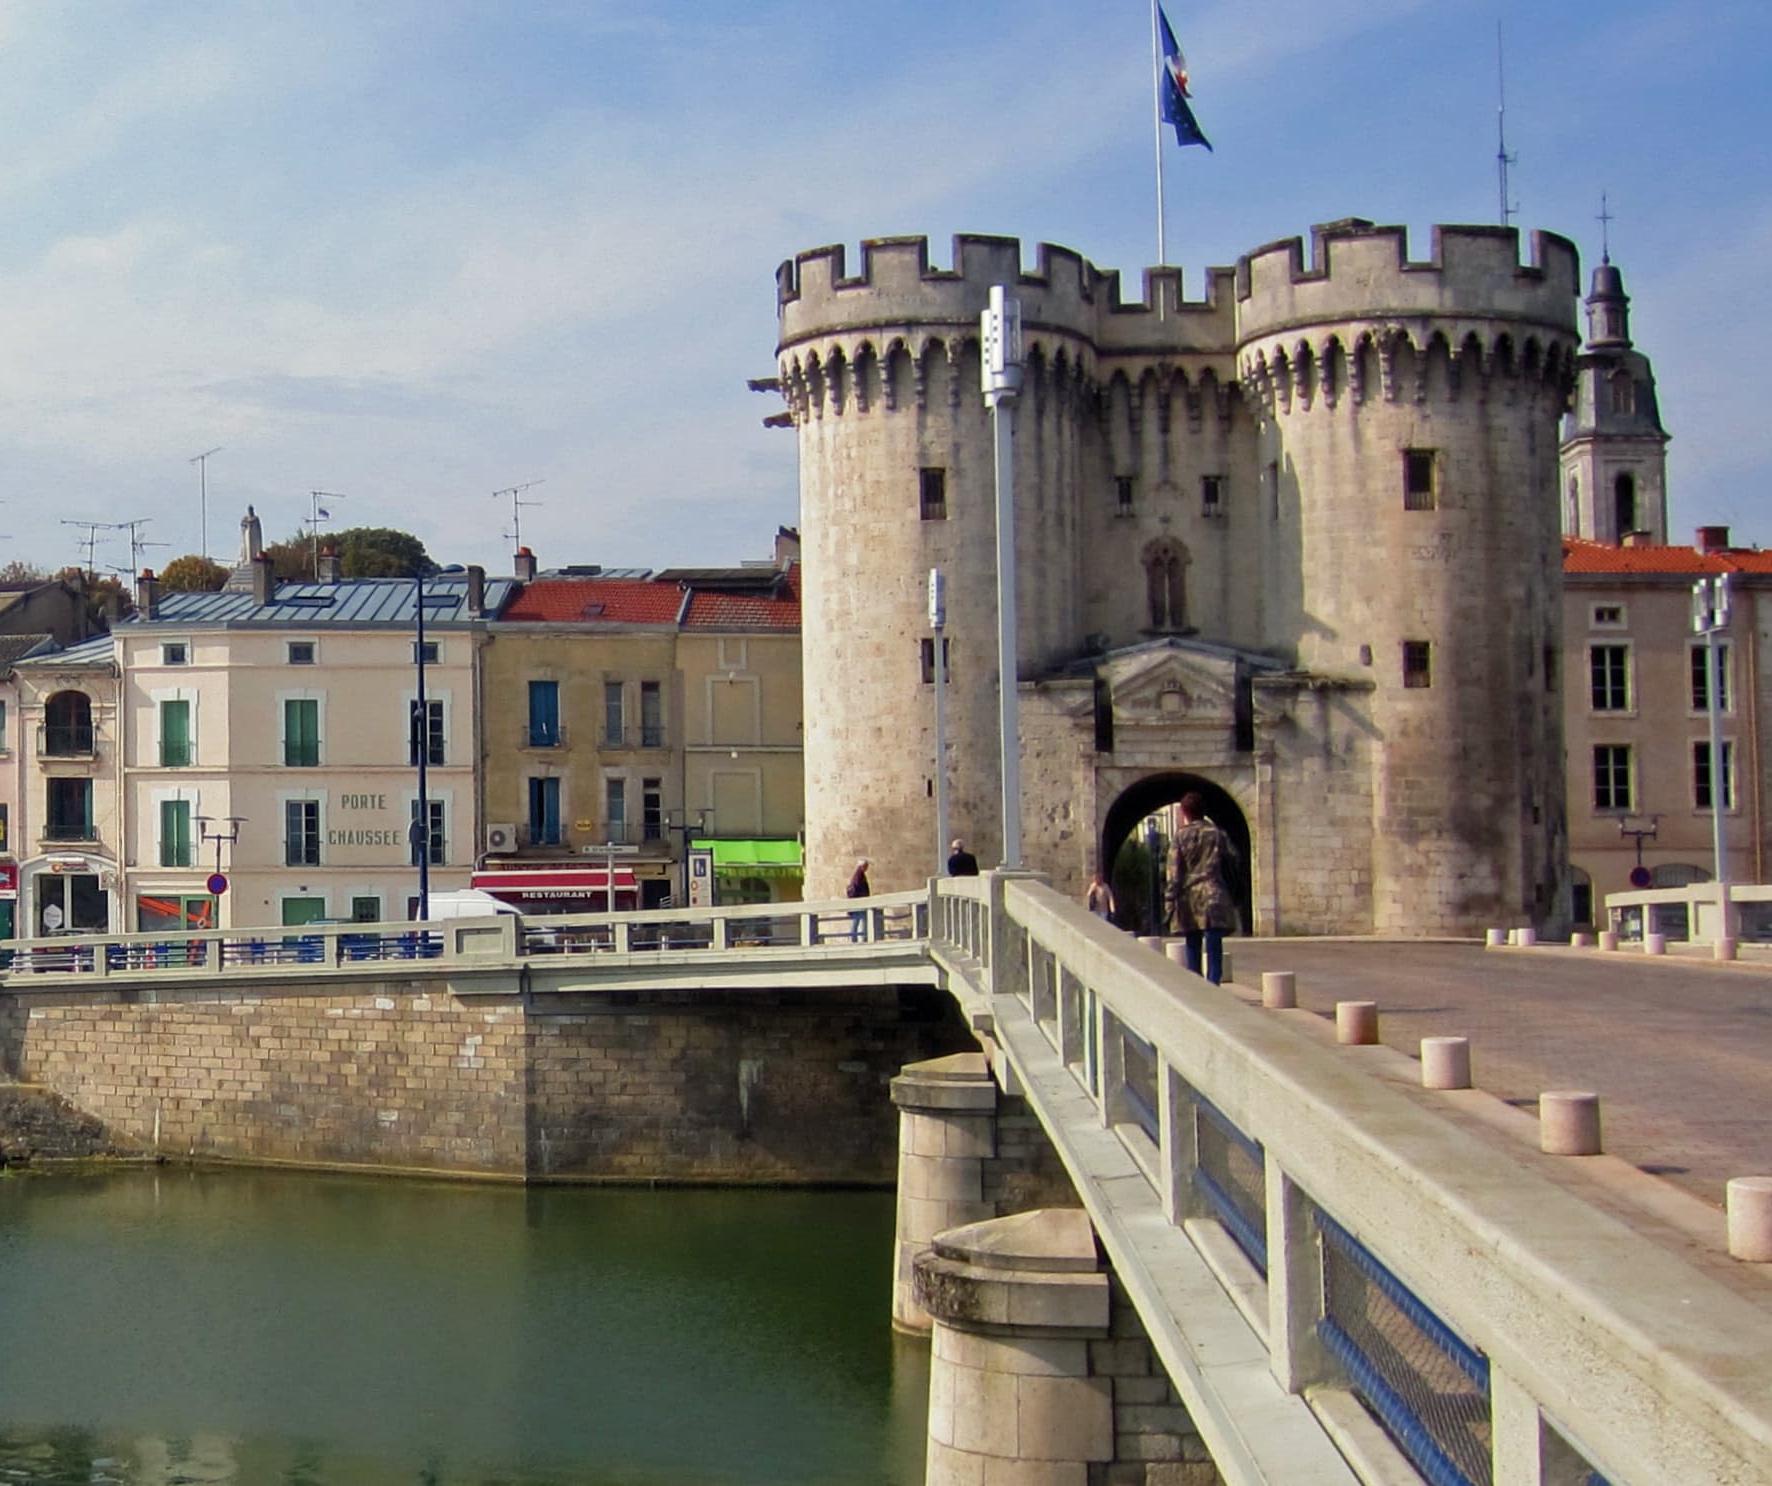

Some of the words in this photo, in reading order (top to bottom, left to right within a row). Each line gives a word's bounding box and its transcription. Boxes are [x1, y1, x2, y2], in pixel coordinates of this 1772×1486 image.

[341, 794, 388, 810] PORTE
[329, 830, 401, 846] CHAUSSEE
[522, 891, 592, 899] RESTAURANT
